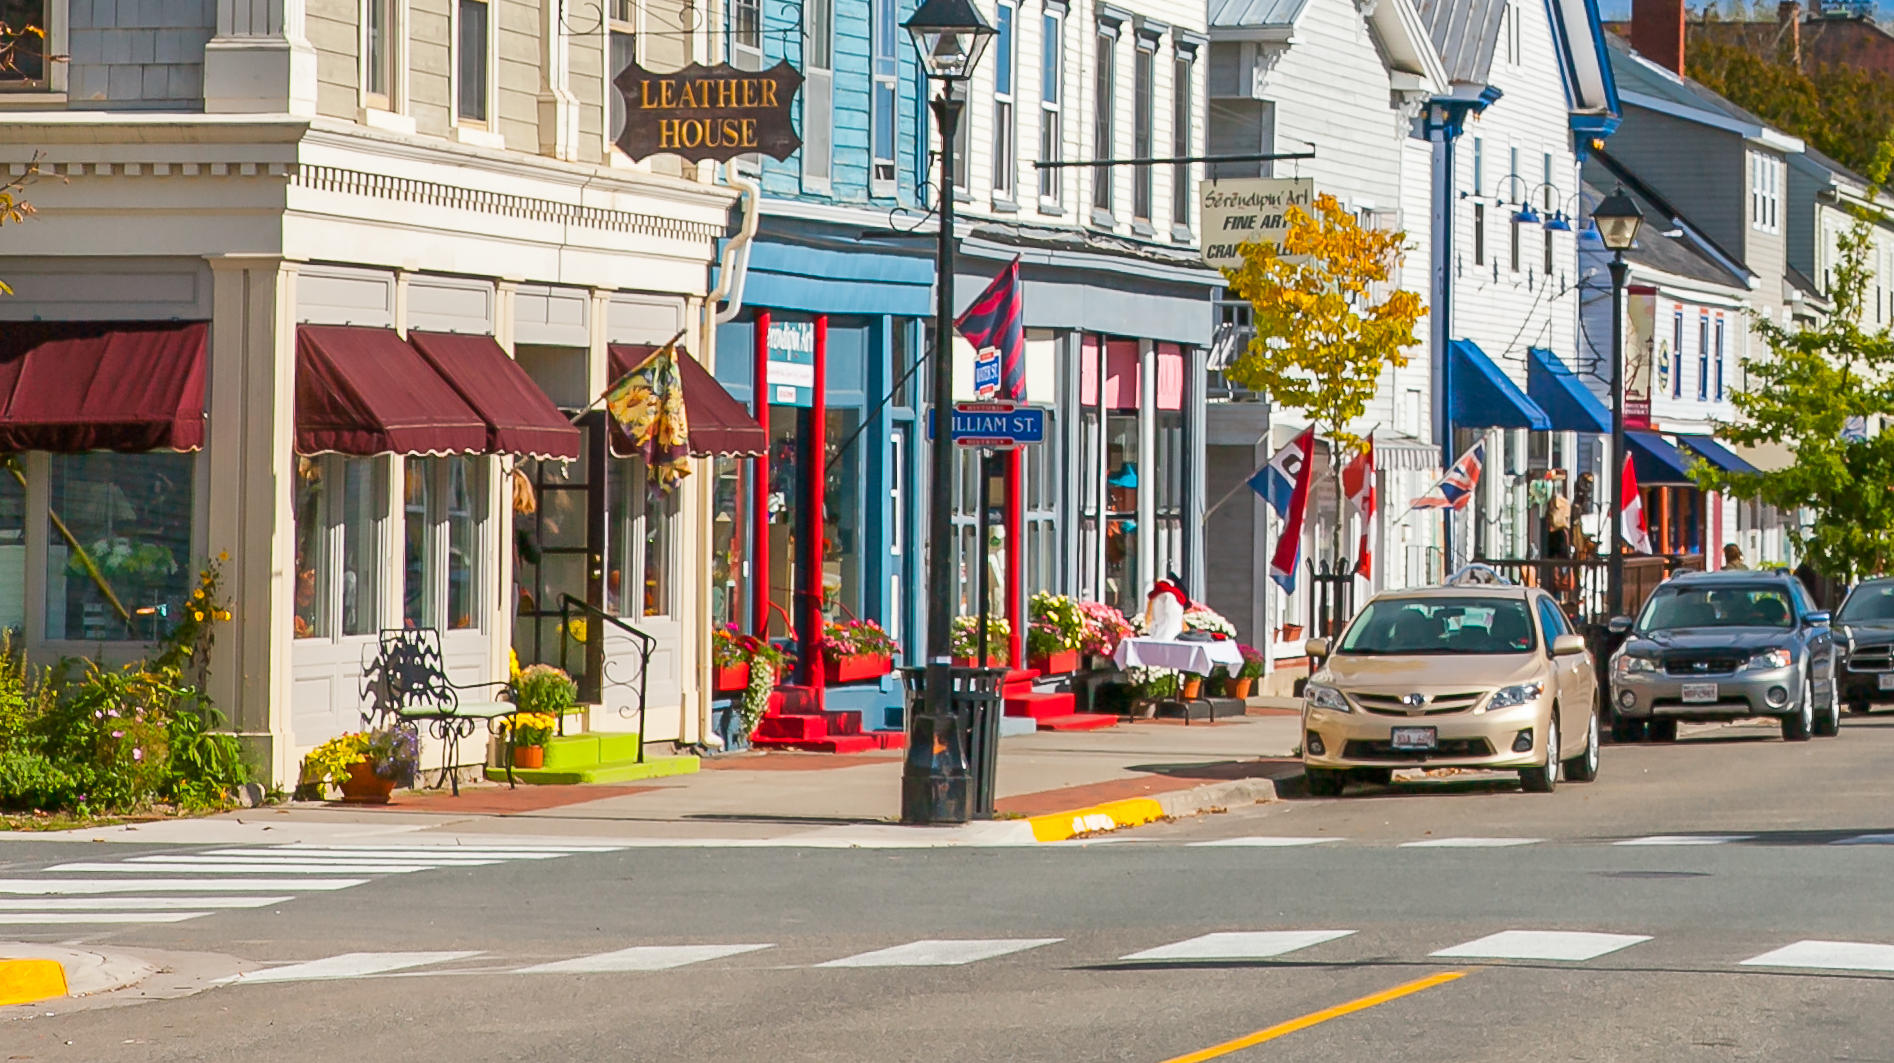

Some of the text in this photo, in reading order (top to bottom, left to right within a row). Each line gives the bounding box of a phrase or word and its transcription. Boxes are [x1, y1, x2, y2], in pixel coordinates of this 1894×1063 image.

[640, 79, 779, 109] LEATHER
[658, 118, 759, 149] HOUSE
[1286, 188, 1308, 205] Art
[1223, 215, 1257, 231] FINE
[951, 416, 1038, 432] ILLIAM ST.
